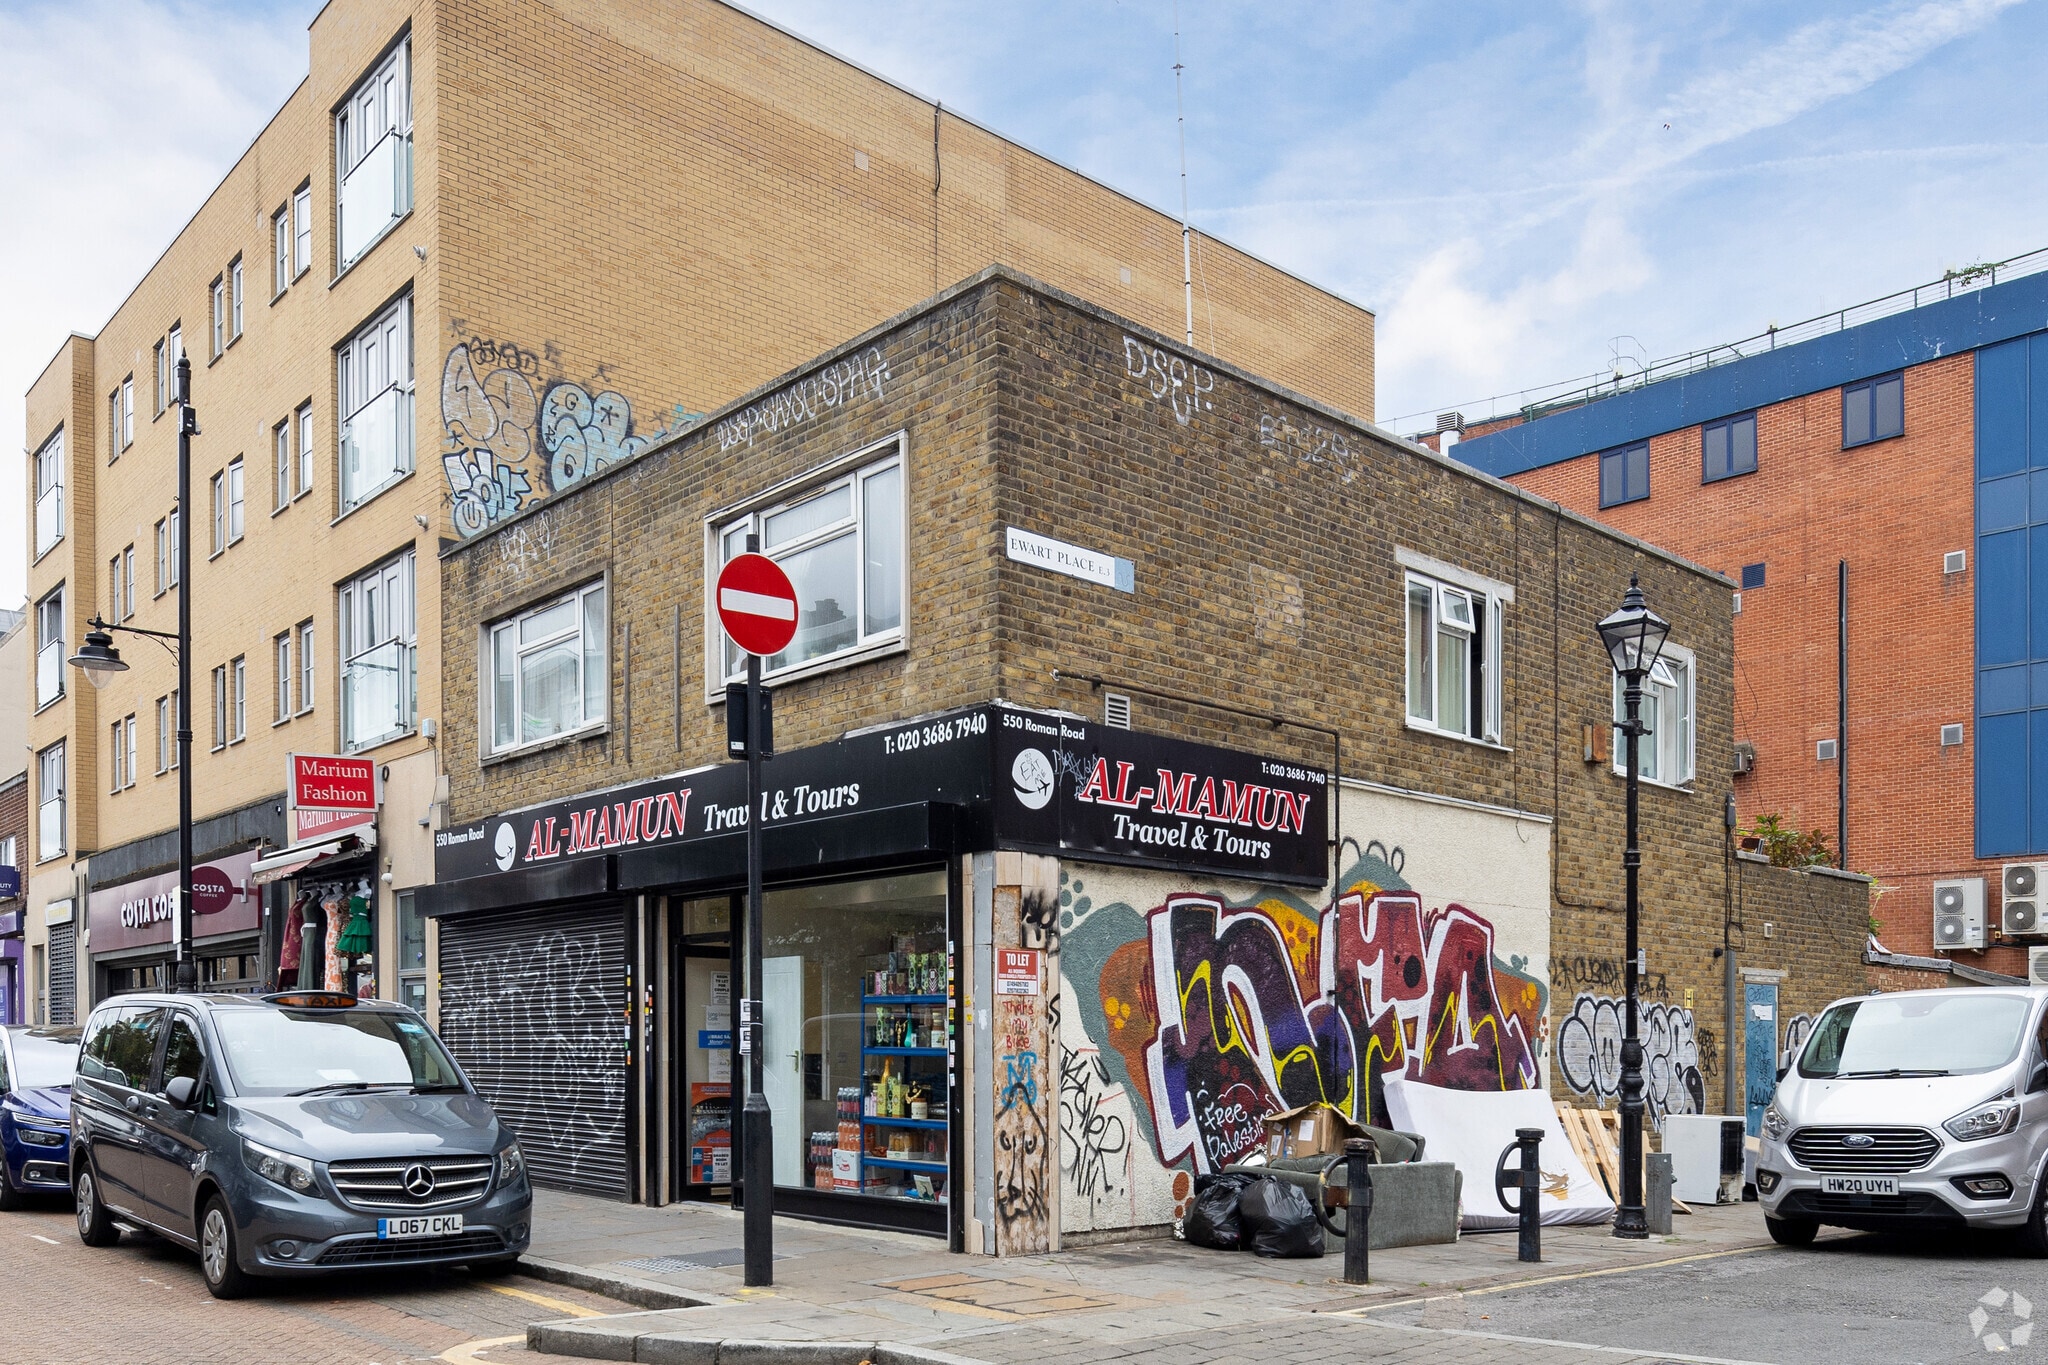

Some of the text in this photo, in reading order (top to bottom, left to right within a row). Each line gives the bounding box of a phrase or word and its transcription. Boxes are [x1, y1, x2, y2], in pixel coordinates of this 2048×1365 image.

[1010, 537, 1052, 560] EWART
[1057, 551, 1095, 572] PLACE
[884, 712, 988, 755] T: 020 3686 7940
[1003, 713, 1086, 740] 550 Roman Road
[301, 760, 368, 779] Marium
[1261, 761, 1326, 785] T: 020 3686 7940
[302, 783, 368, 802] Fashion
[1079, 757, 1310, 835] AL-MAMUN
[524, 782, 860, 862] AL-MAMUN Travl & Tours
[436, 825, 485, 847] 550 Roman Road
[1113, 813, 1272, 860] Travel & Tours
[192, 883, 225, 893] COSTA
[121, 897, 151, 928] COSTA
[1006, 952, 1030, 967] TO LET
[1827, 1178, 1893, 1193] HW20 UYH
[389, 1216, 460, 1235] LO67 CKL
